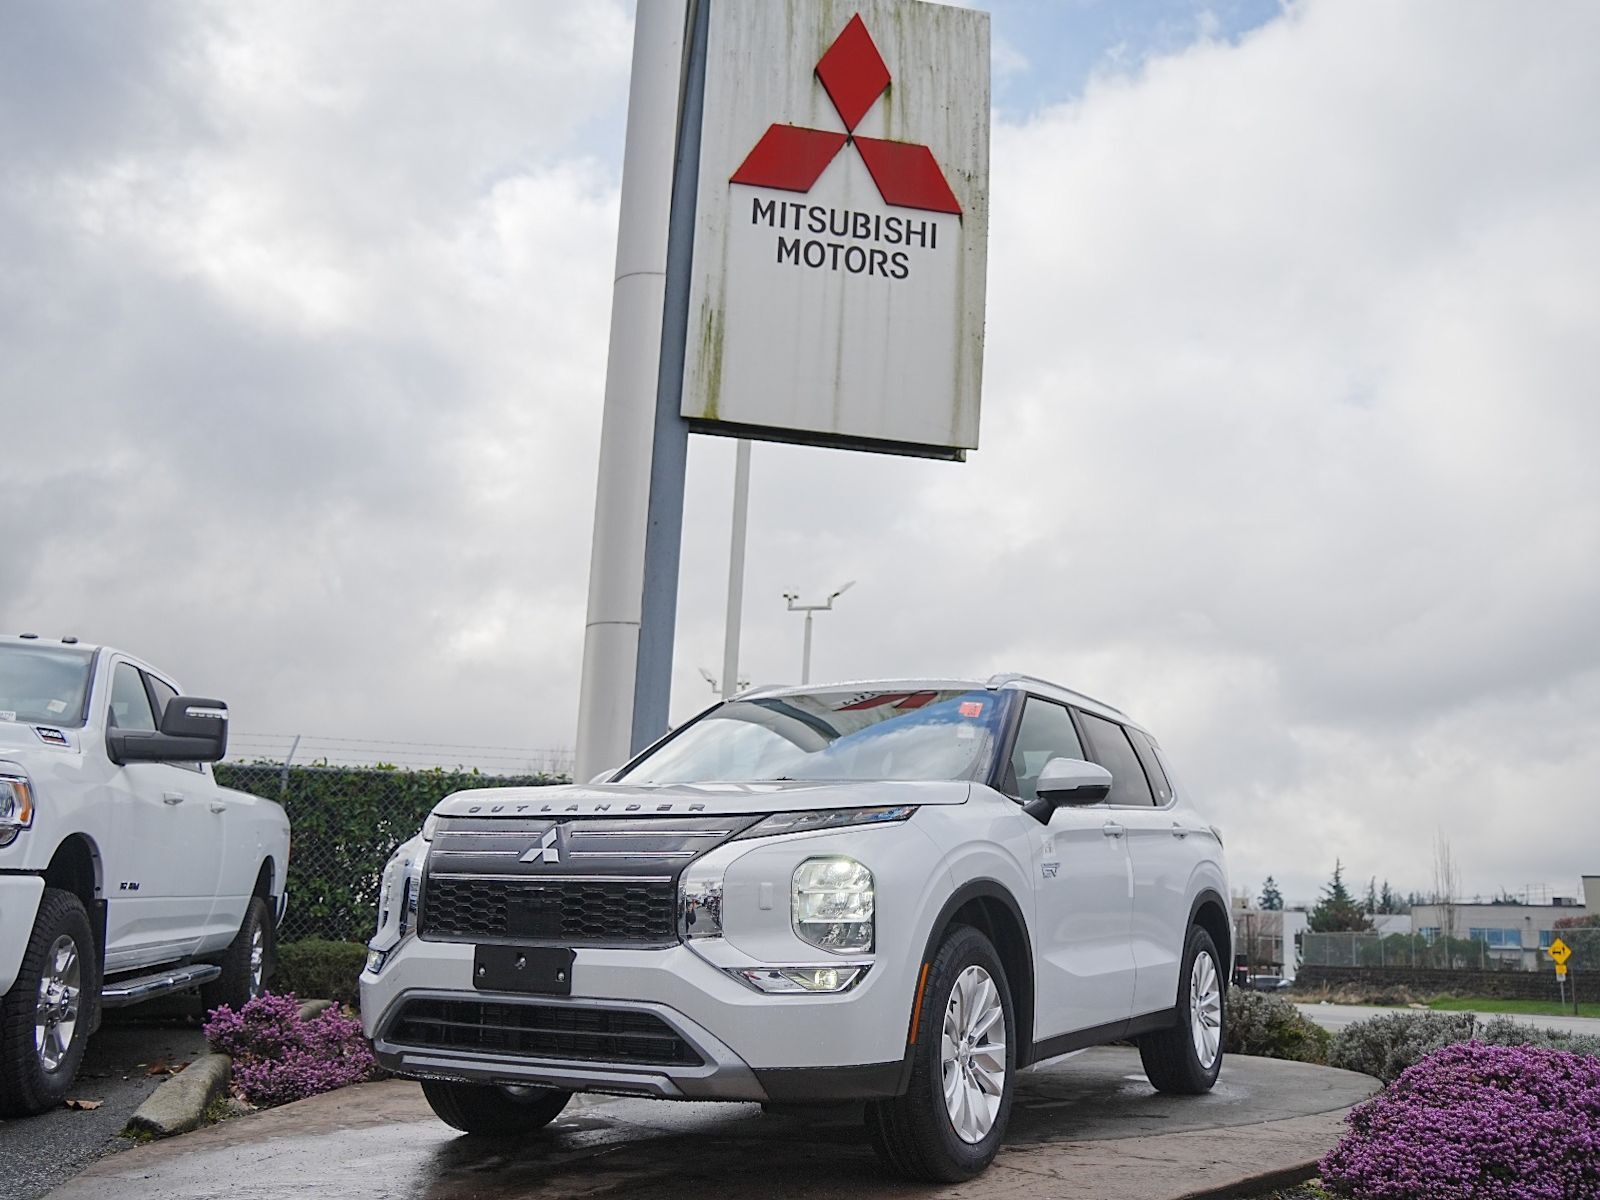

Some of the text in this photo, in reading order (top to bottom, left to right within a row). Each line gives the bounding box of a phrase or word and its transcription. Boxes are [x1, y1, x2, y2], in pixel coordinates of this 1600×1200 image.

[752, 198, 937, 249] MITSUBISHI
[777, 236, 909, 279] MOTORS
[469, 803, 706, 814] OUTLANDER
